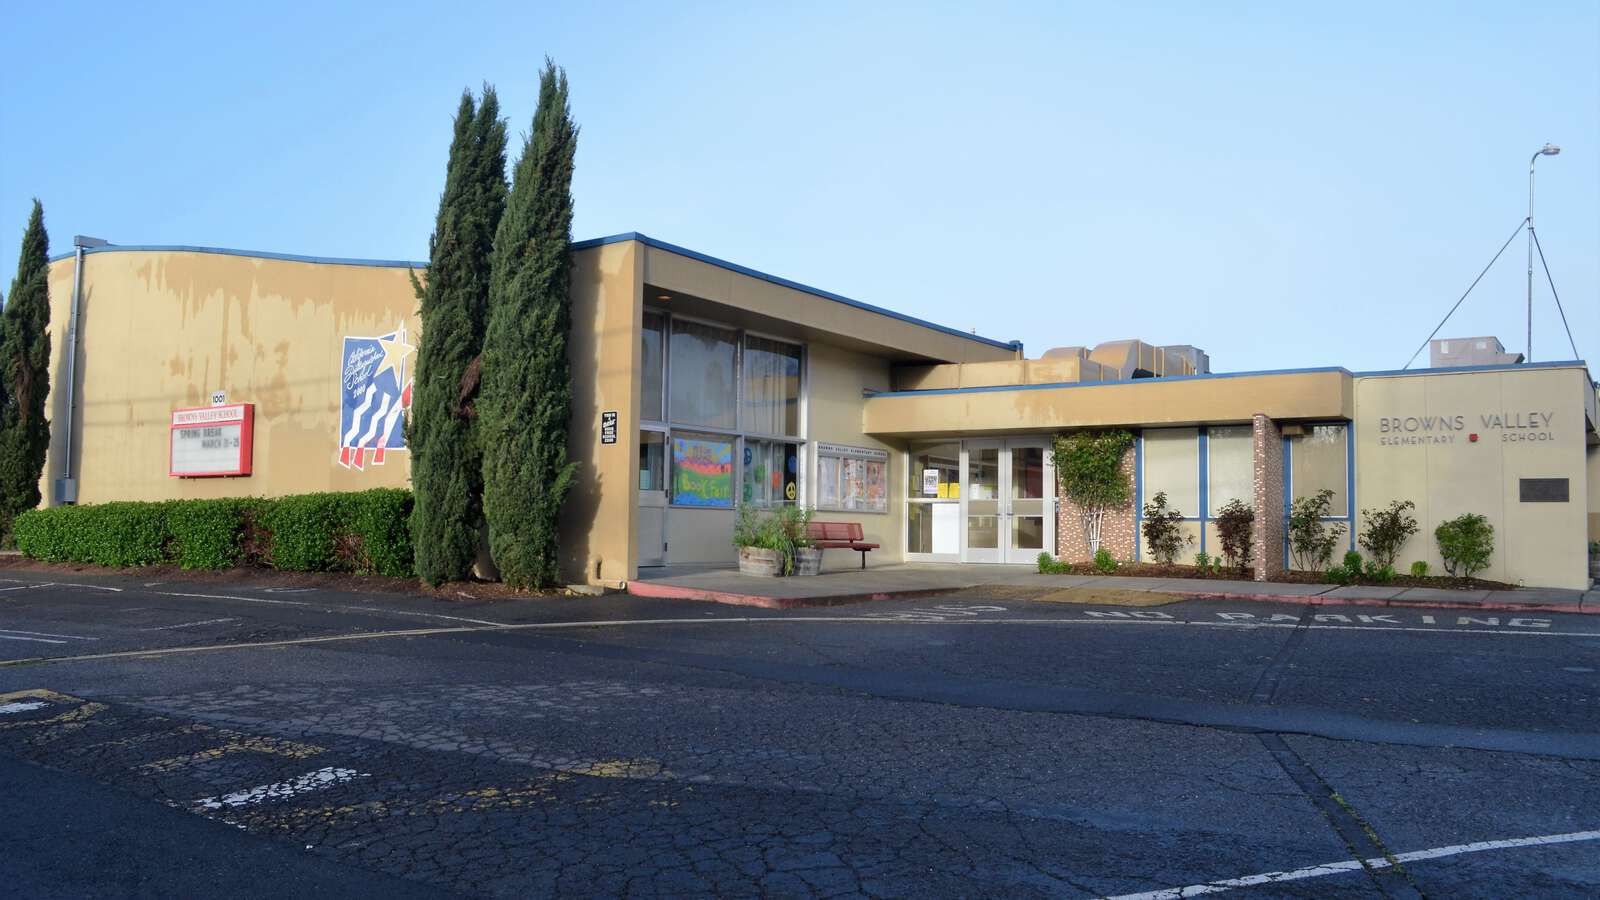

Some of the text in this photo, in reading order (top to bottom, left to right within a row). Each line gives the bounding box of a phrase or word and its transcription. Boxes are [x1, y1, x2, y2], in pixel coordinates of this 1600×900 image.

[212, 395, 225, 403] 1001
[177, 409, 238, 422] BROWNS VALLEY SCHOOL
[1380, 412, 1553, 433] BROWNS VALLEY
[180, 427, 222, 440] SPRING BREAK
[1380, 432, 1555, 446] ELEMENTARY SCHOOL
[202, 439, 222, 448] MARCH
[1083, 611, 1552, 628] NO PARKING
